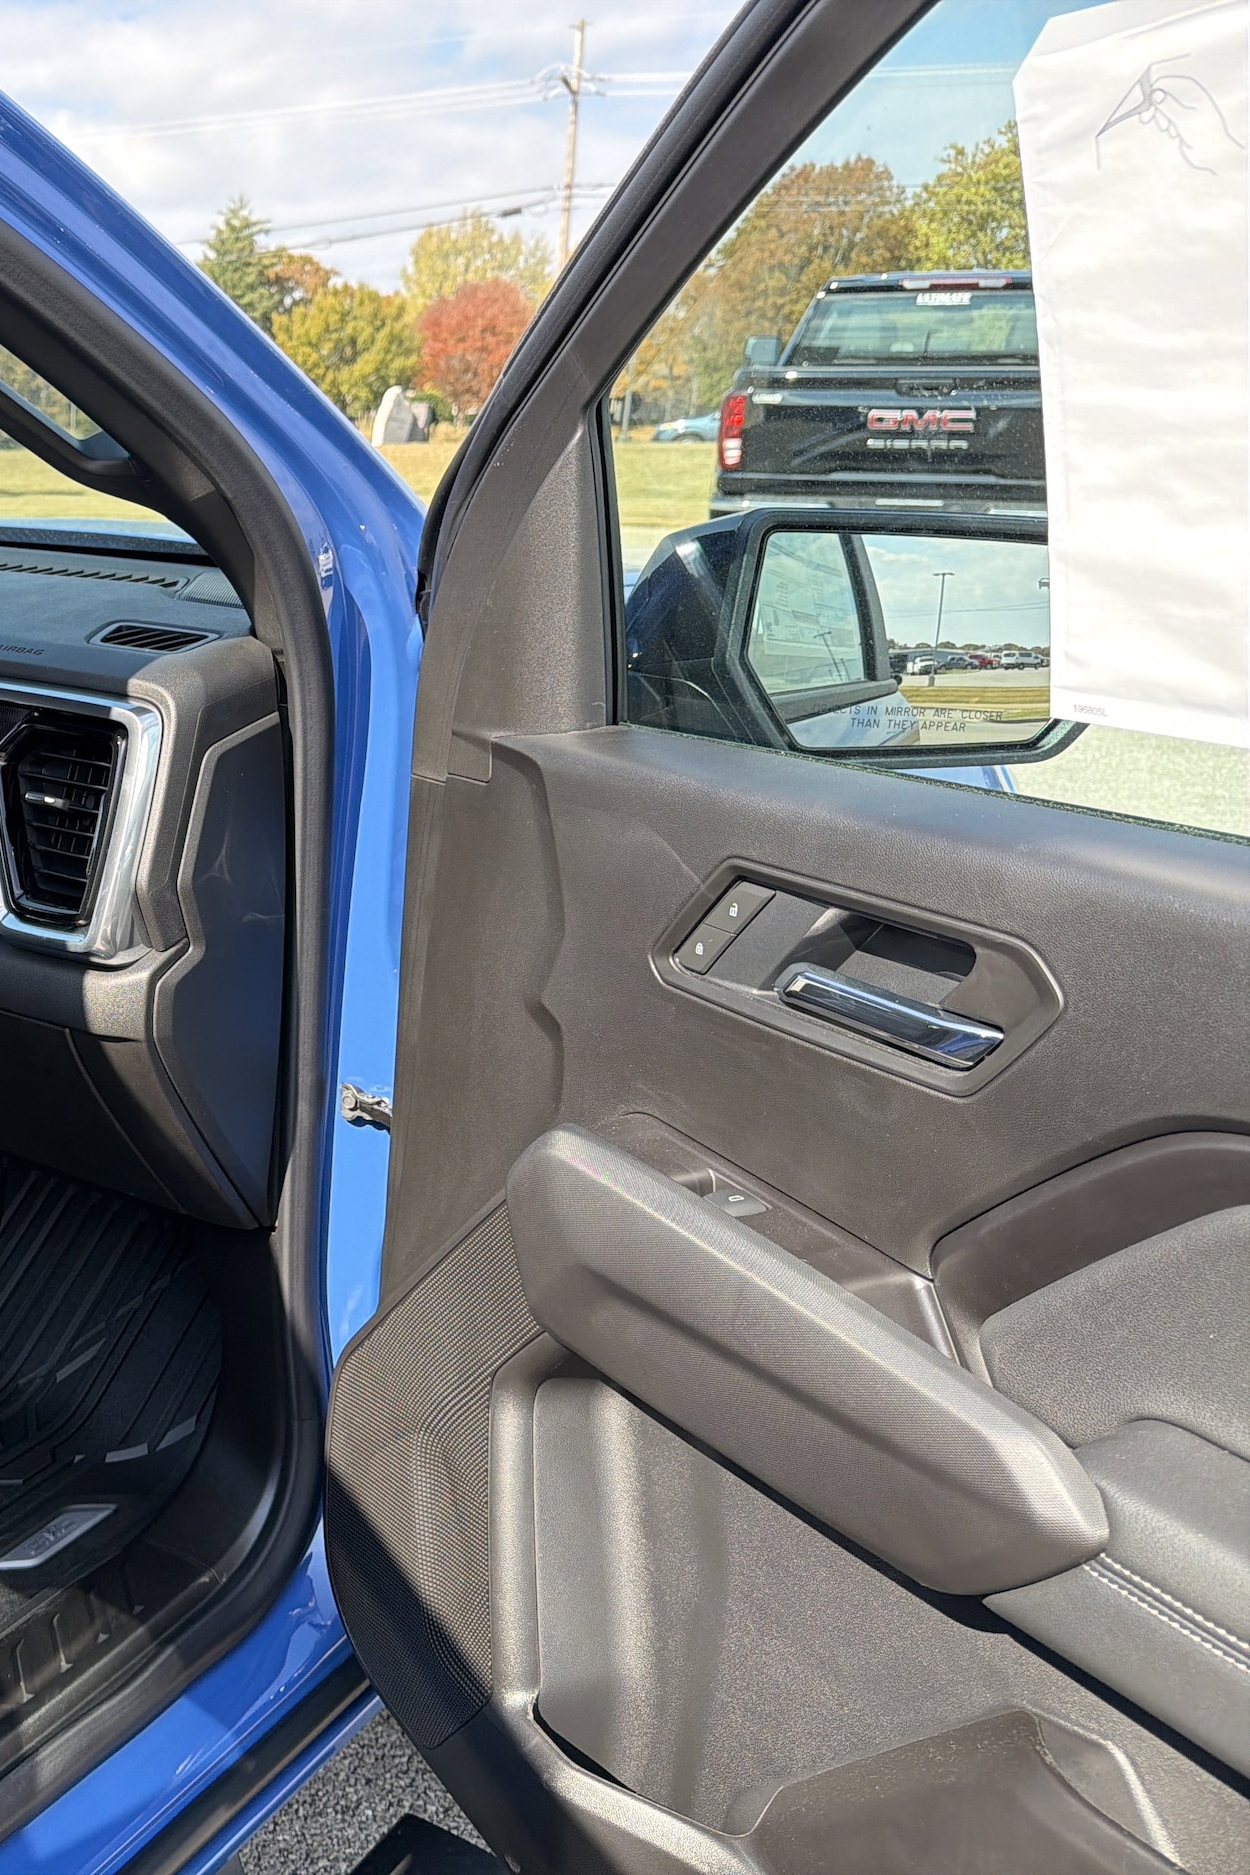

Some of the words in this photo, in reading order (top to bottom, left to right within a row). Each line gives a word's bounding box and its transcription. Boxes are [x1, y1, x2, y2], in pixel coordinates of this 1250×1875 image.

[867, 409, 976, 431] GMC
[867, 705, 878, 715] IN
[885, 706, 926, 717] MIRROR
[932, 708, 953, 718] ARE
[961, 710, 1003, 720] CLOSER
[850, 718, 880, 729] THAN
[887, 719, 916, 730] THEY
[920, 721, 966, 732] APPEAR
